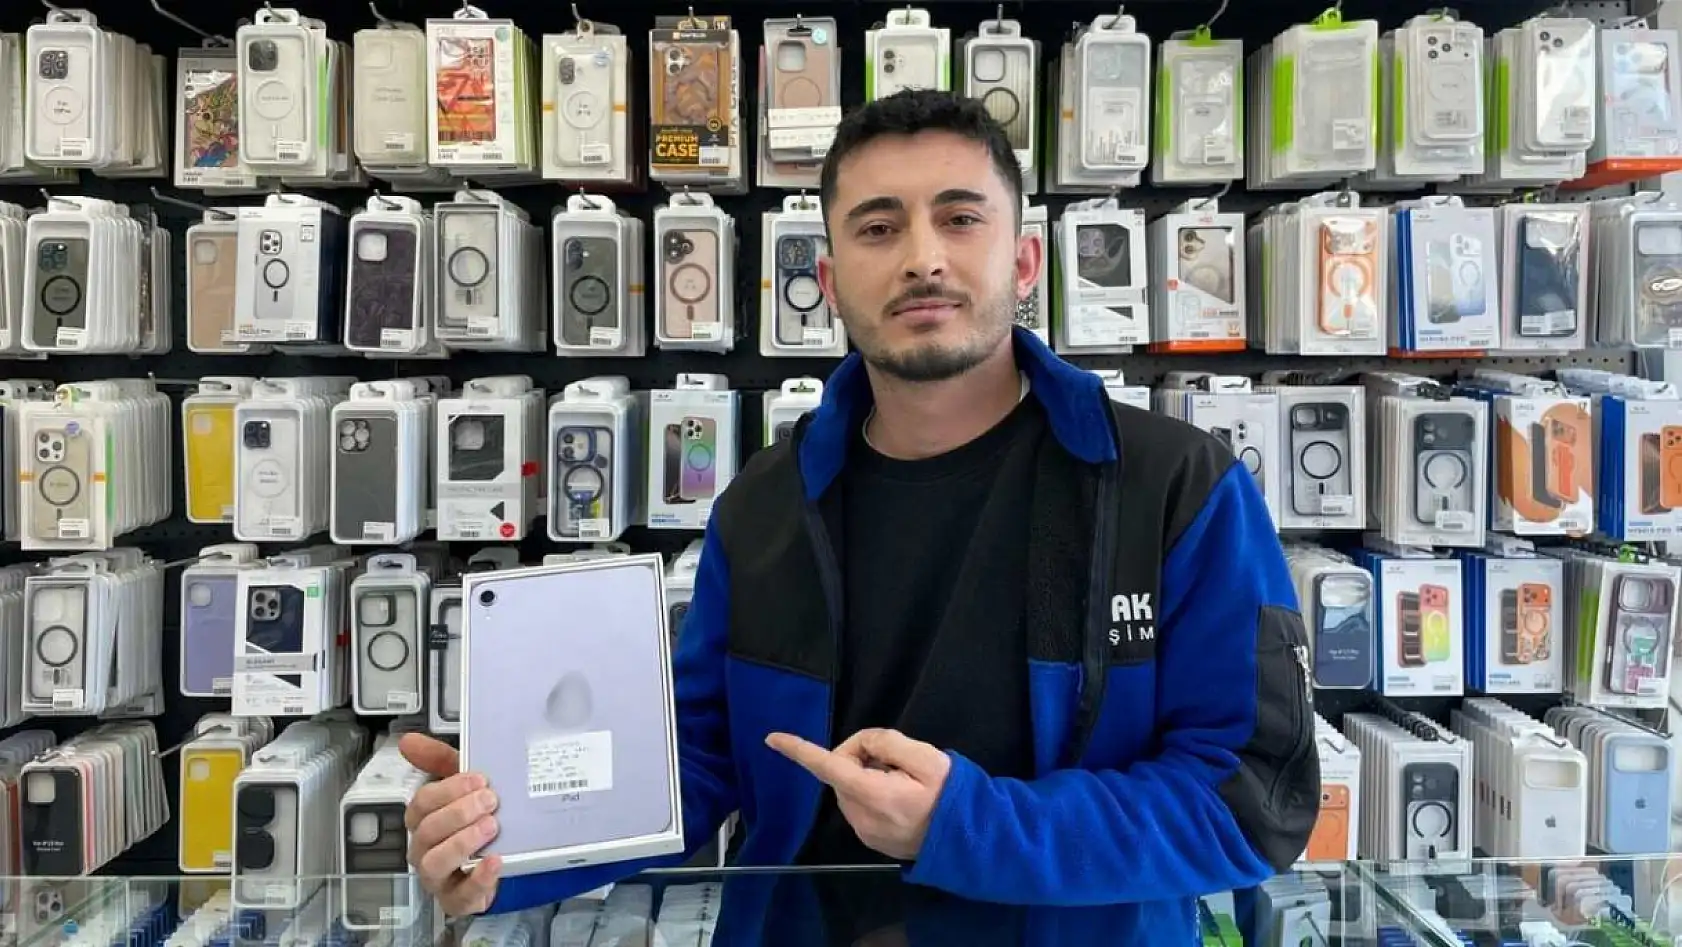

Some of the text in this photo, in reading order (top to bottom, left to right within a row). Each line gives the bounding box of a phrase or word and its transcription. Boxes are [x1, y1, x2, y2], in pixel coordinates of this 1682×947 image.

[656, 134, 698, 143] PREMIUM
[656, 143, 699, 157] CASE
[1111, 592, 1153, 622] AK
[1108, 622, 1154, 646] ŞİM
